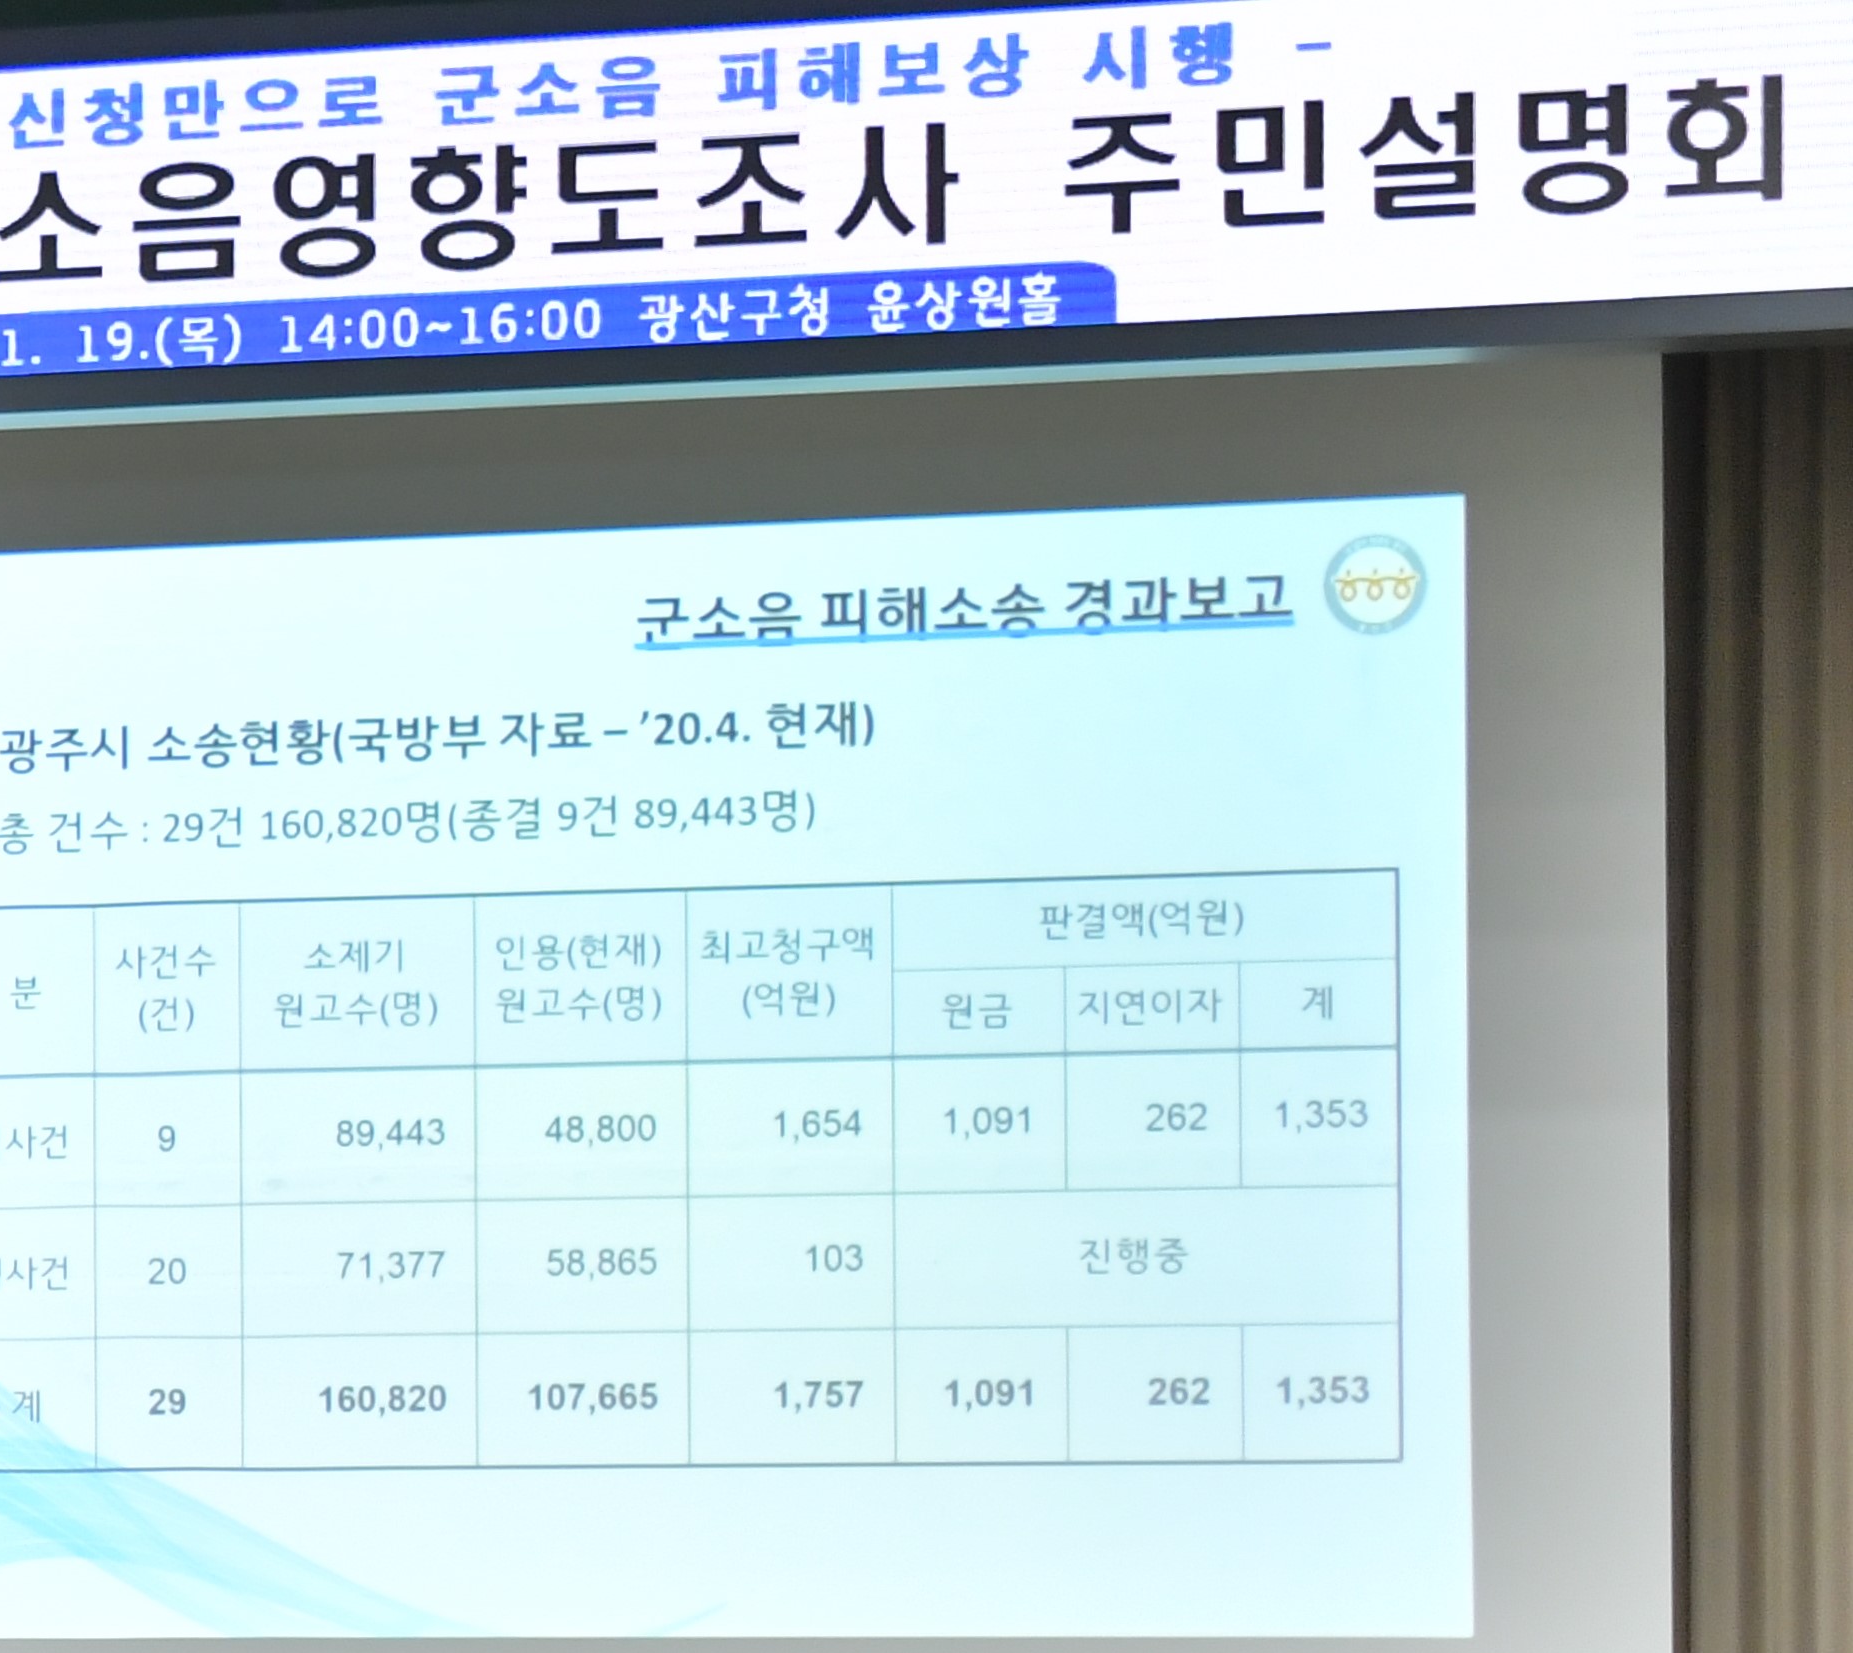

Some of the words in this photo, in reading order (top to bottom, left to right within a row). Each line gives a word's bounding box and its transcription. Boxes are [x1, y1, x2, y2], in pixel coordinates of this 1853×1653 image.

[8, 75, 383, 149] 신청만으로
[433, 55, 661, 126] 군소음
[716, 32, 1030, 111] 피해보상
[1083, 22, 1233, 89] 시행
[1064, 73, 1783, 235] 주민설명회
[77, 313, 242, 368] 19.(목)
[278, 298, 602, 354] 14:00~16:00
[638, 283, 829, 344] 광산구청
[867, 271, 1062, 334] 윤상원홀
[636, 591, 803, 643] 군소음
[820, 583, 1047, 637] 피해소송
[1065, 574, 1294, 632] 경과보고
[147, 714, 487, 769] 소송현황(국방부
[499, 711, 592, 758] 자료
[766, 700, 875, 750] 현재)
[49, 811, 128, 854] 건수
[163, 806, 242, 849] 29건
[261, 797, 540, 844] 160,820명(종결
[557, 794, 617, 838] 9건
[634, 789, 816, 833] 89,443명)
[1040, 899, 1245, 941] 판결액(억원)
[115, 944, 216, 980] 사건수
[304, 939, 403, 974] 소제기
[495, 932, 662, 972] 인용(현재)
[701, 926, 874, 966] 최고청구액
[138, 996, 195, 1034] (건)
[274, 991, 438, 1029] 원고수(명)
[496, 985, 662, 1024] 원고수(명)
[742, 981, 836, 1020] (억원)
[942, 993, 1012, 1030] 원금
[1078, 987, 1223, 1027] 지연이자
[1301, 984, 1334, 1021] 계
[544, 1113, 657, 1148] 48,800
[774, 1108, 862, 1143] 1,654
[944, 1105, 1030, 1140] 1,091
[1145, 1101, 1208, 1133] 262
[1275, 1098, 1369, 1134] 1,353
[157, 1124, 176, 1153] 9
[336, 1118, 446, 1151] 89,443
[148, 1257, 187, 1286] 20
[337, 1250, 446, 1283] 71,377
[547, 1247, 658, 1281] 58,865
[806, 1243, 864, 1273] 103
[1079, 1237, 1189, 1276] 진행중
[11, 1389, 41, 1425] 계
[148, 1388, 187, 1416] 29
[318, 1384, 447, 1417] 160,820
[528, 1382, 659, 1416] 107,665
[774, 1379, 864, 1414] 1,757
[944, 1378, 1033, 1413] 1,091
[1148, 1376, 1210, 1406] 262
[1276, 1375, 1370, 1410] 1,353
